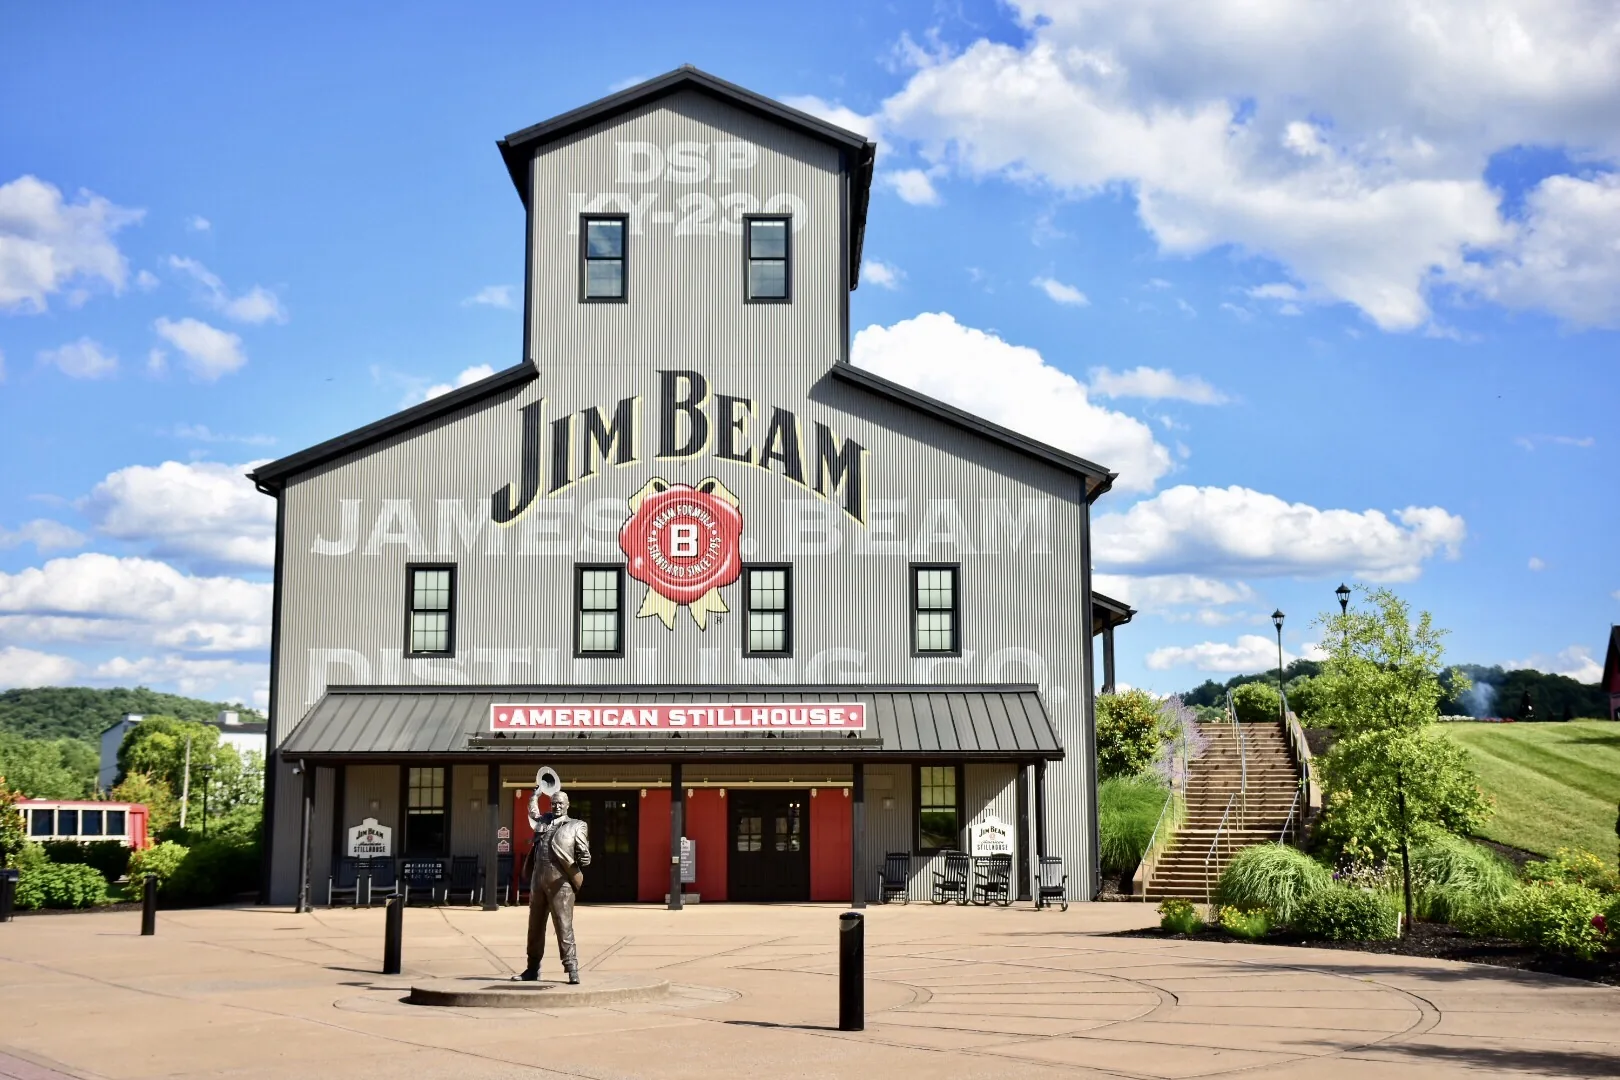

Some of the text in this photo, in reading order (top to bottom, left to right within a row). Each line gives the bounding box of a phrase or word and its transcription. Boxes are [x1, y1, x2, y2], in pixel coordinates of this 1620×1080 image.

[615, 140, 760, 184] DSP
[491, 369, 872, 531] JIM BEAM
[309, 497, 1054, 557] JAMES BEAM
[653, 504, 716, 530] BEAM FORMULA
[647, 543, 685, 578] STANDARD
[686, 557, 712, 578] SINCE
[706, 537, 721, 560] 1795
[670, 523, 699, 558] B
[508, 707, 846, 727] AMERICAN STILLHOUSE
